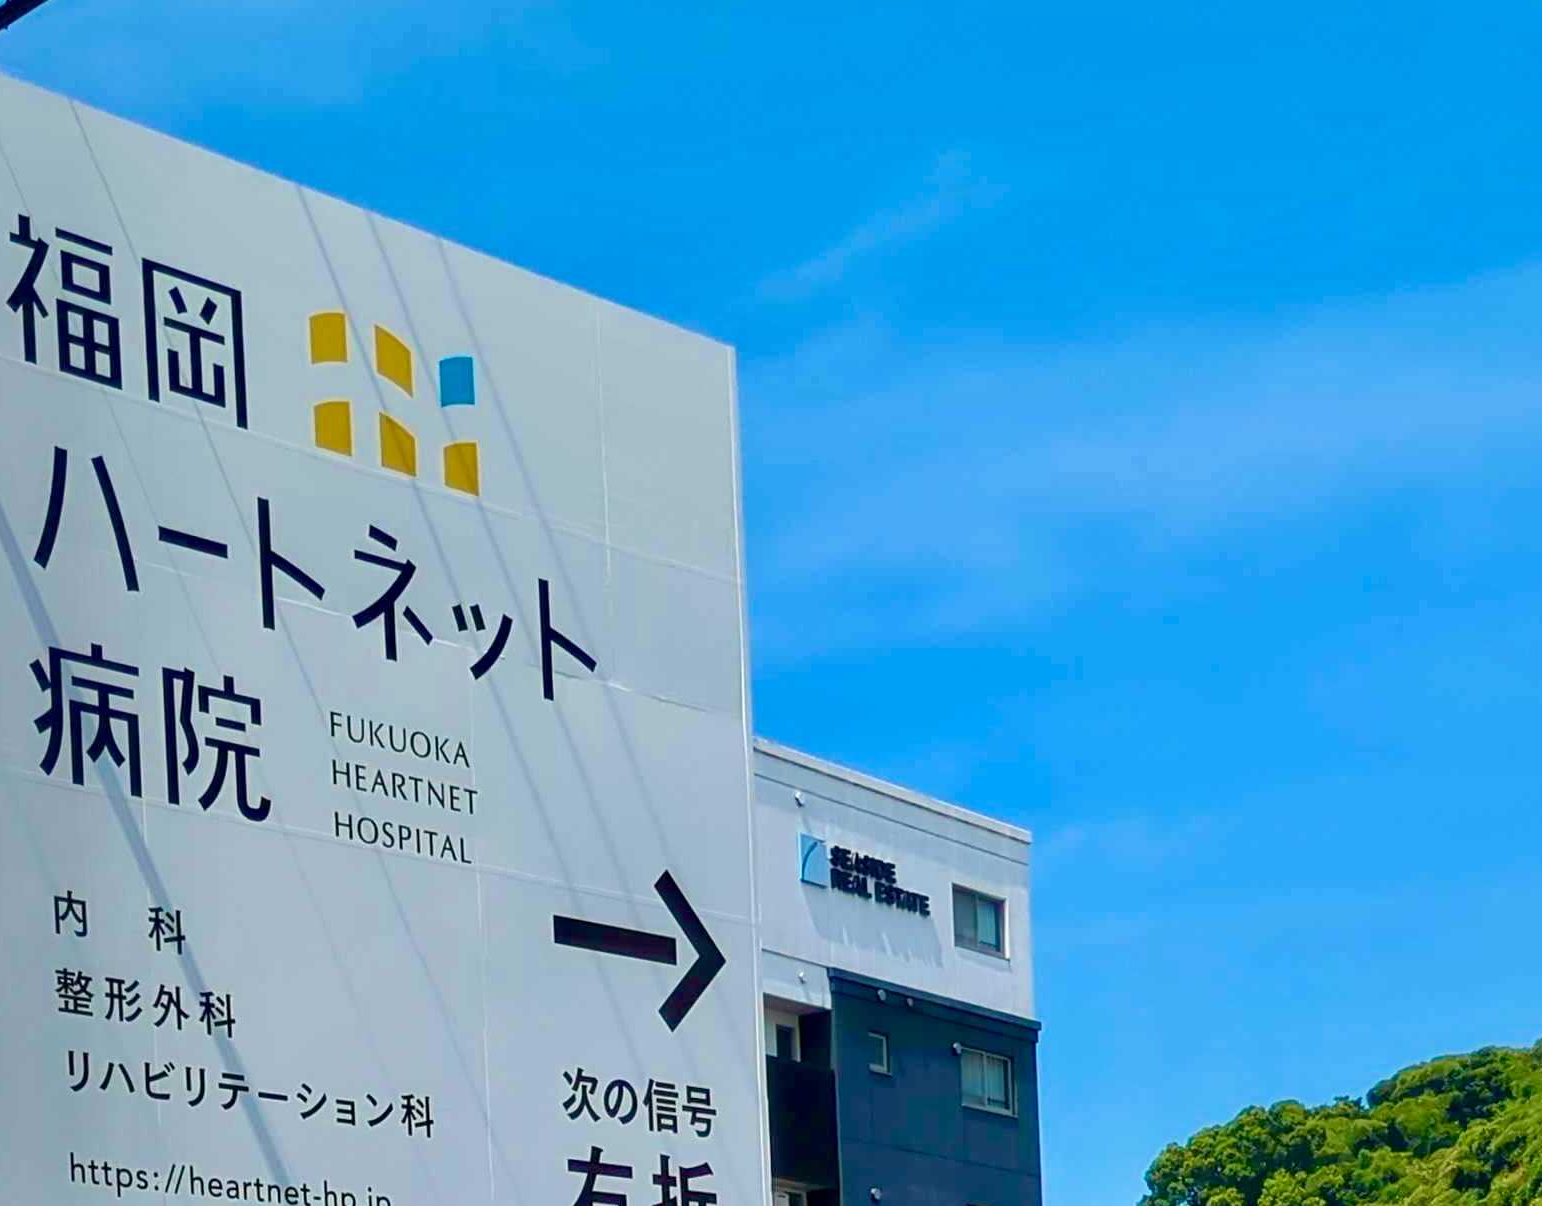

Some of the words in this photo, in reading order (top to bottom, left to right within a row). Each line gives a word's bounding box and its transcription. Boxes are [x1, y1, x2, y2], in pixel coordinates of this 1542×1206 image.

[5, 213, 249, 430] 福岡
[33, 445, 597, 700] ハートネット
[29, 643, 272, 822] 病院
[328, 711, 471, 770] FUKUOKA
[331, 759, 479, 816] HEARTNET
[333, 810, 473, 865] HOSPITAL
[53, 967, 237, 1039] 整形外科
[64, 1048, 436, 1140] リハビリテーション科
[561, 1067, 717, 1138] 次の信号
